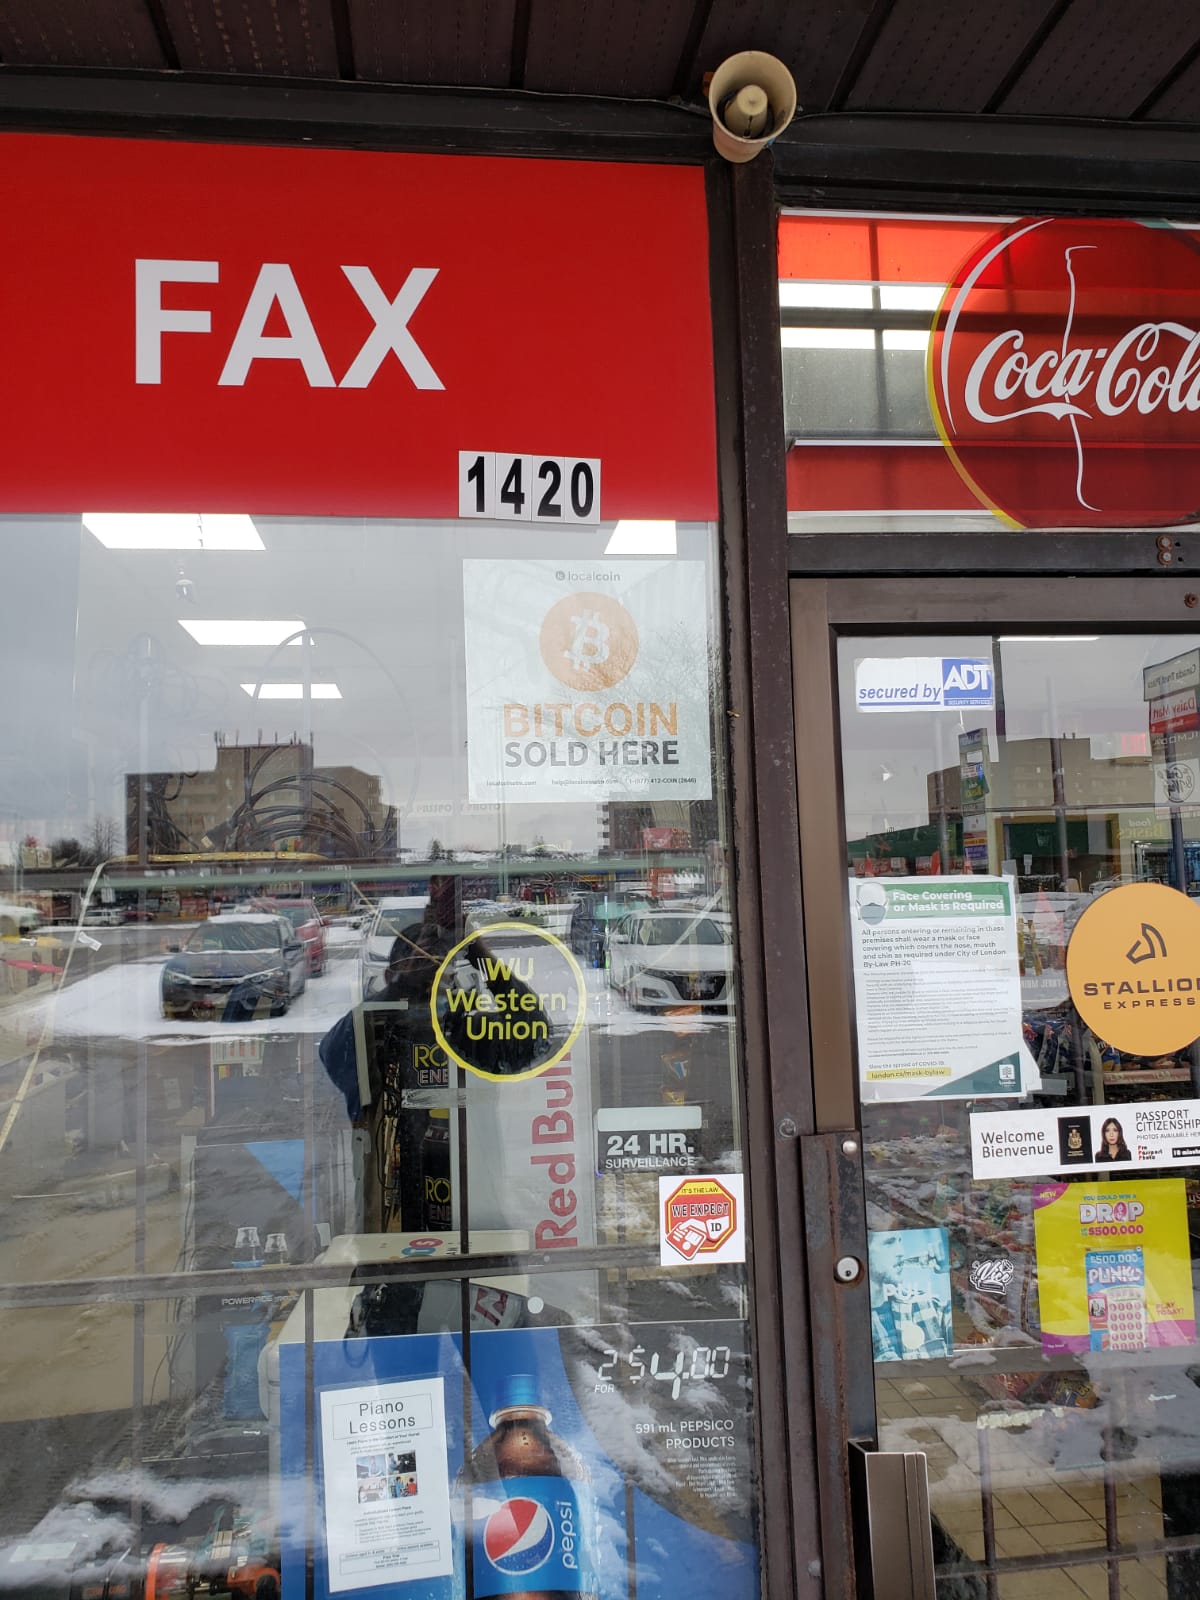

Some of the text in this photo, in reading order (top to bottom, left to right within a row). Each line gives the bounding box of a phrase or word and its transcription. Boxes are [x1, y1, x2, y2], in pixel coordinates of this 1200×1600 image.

[135, 259, 446, 390] FAX
[468, 456, 593, 517] 1420
[568, 570, 620, 582] localcoin
[944, 665, 992, 691] ADT
[859, 683, 941, 701] secured by
[503, 702, 678, 737] BITCOIN
[505, 741, 679, 767] SOLD HERE
[893, 890, 972, 903] Face Covering
[893, 900, 1004, 913] or Mask is Required
[872, 929, 900, 937] persons
[901, 928, 931, 936] entering
[941, 926, 976, 934] remaining
[862, 937, 894, 945] premises
[863, 944, 892, 952] covering
[904, 951, 933, 959] required
[957, 950, 970, 958] City
[477, 957, 534, 981] WU
[446, 988, 565, 1012] Western
[1104, 997, 1195, 1010] EXPRESS
[466, 1014, 547, 1040] Union
[1136, 1109, 1189, 1122] PASSPORT
[1136, 1118, 1200, 1132] CITIZENSHIP
[607, 1133, 694, 1156] 24 HR.
[981, 1129, 1045, 1145] Welcome
[982, 1144, 1053, 1159] Bienvenue
[605, 1156, 695, 1169] SURVEILLANCE
[531, 1153, 578, 1250] Red
[1039, 1191, 1057, 1199] NEW
[672, 1203, 729, 1217] WE EXPECT
[1079, 1201, 1144, 1224] DROP
[711, 1222, 722, 1232] ID
[1088, 1225, 1144, 1237] $500,000
[976, 1261, 1010, 1283] Vice
[599, 1344, 731, 1400] 2 $4.00
[594, 1384, 615, 1393] FOR
[359, 1401, 404, 1417] Piano
[350, 1415, 416, 1434] Lessons
[635, 1419, 734, 1434] 591 mL PEPSICO
[666, 1436, 735, 1449] PRODUCTS
[557, 1501, 578, 1569] pepsi
